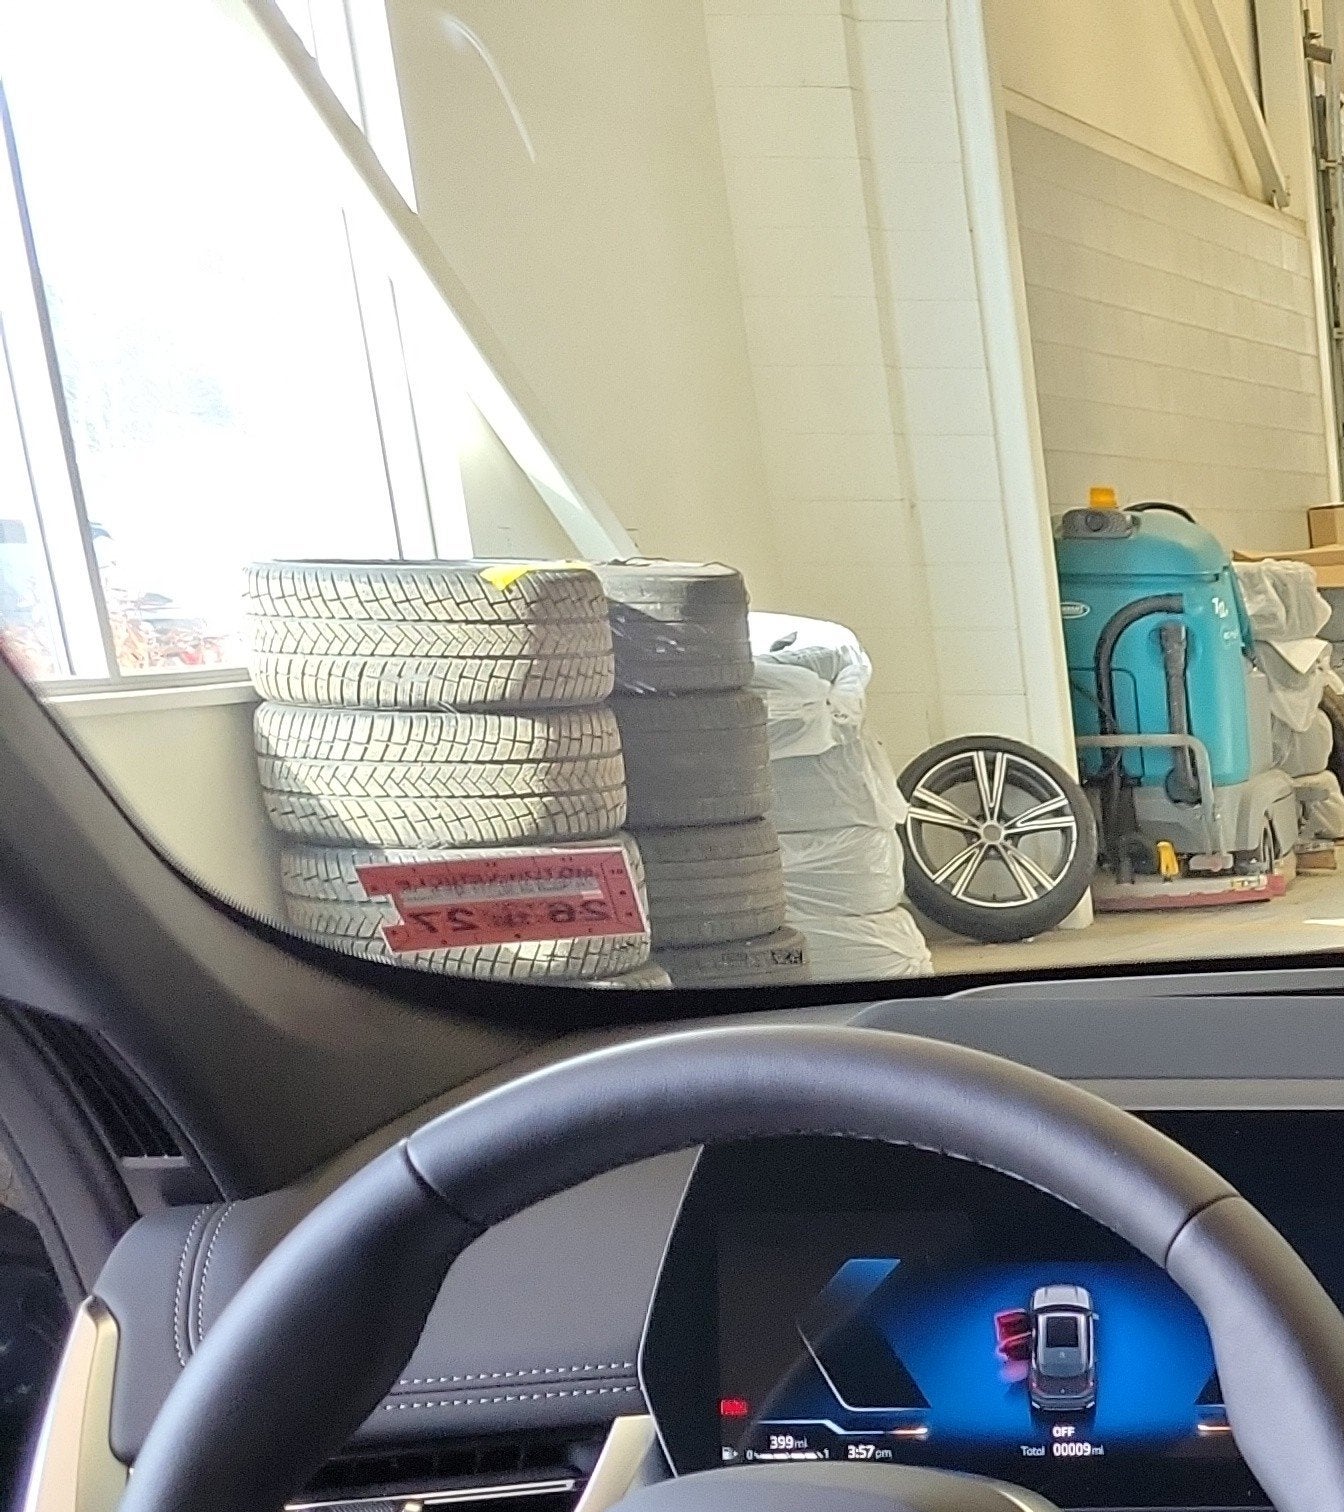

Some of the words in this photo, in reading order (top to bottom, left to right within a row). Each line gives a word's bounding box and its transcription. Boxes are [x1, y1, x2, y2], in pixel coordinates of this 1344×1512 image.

[1052, 1425, 1076, 1438] OFF
[769, 1436, 794, 1450] 399
[1020, 1445, 1046, 1457] Total
[1052, 1442, 1091, 1457] 00009
[848, 1445, 876, 1459] 3:57
